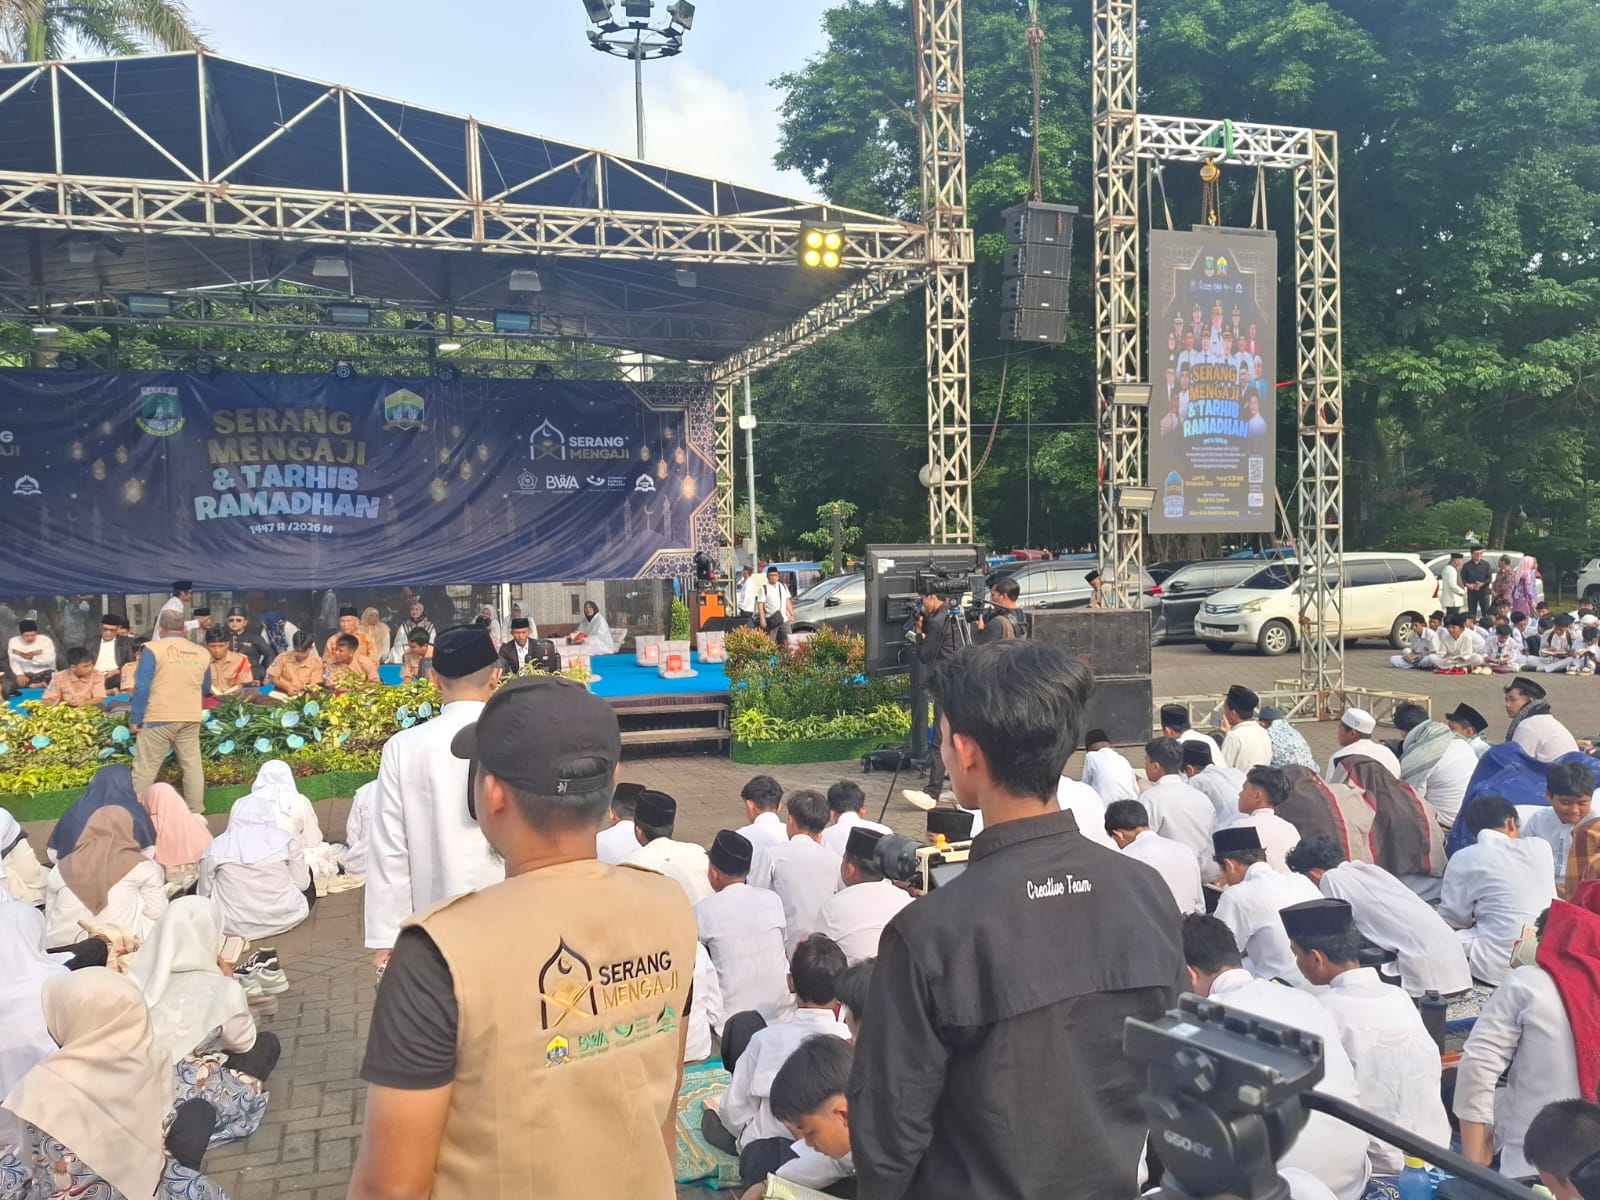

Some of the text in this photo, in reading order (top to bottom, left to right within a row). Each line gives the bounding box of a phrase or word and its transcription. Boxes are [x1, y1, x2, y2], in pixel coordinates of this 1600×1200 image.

[1192, 365, 1236, 382] SERANG
[1189, 385, 1240, 400] MENGAJI
[1198, 400, 1240, 417] TARHIB
[213, 407, 351, 435] SERANG
[1183, 418, 1249, 437] RAMADHAN
[208, 438, 366, 465] MENGAJI
[569, 436, 625, 448] SERANG
[569, 448, 630, 460] MENGAJI
[212, 463, 358, 491] & TARHIB
[546, 473, 580, 489] BWA
[193, 491, 381, 520] RAMADHAN
[249, 523, 275, 534] 1447
[276, 522, 285, 531] H
[322, 524, 333, 534] M
[1026, 875, 1091, 899] Creative Team
[599, 951, 672, 986] SERANG
[602, 971, 678, 1010] MENGAJI
